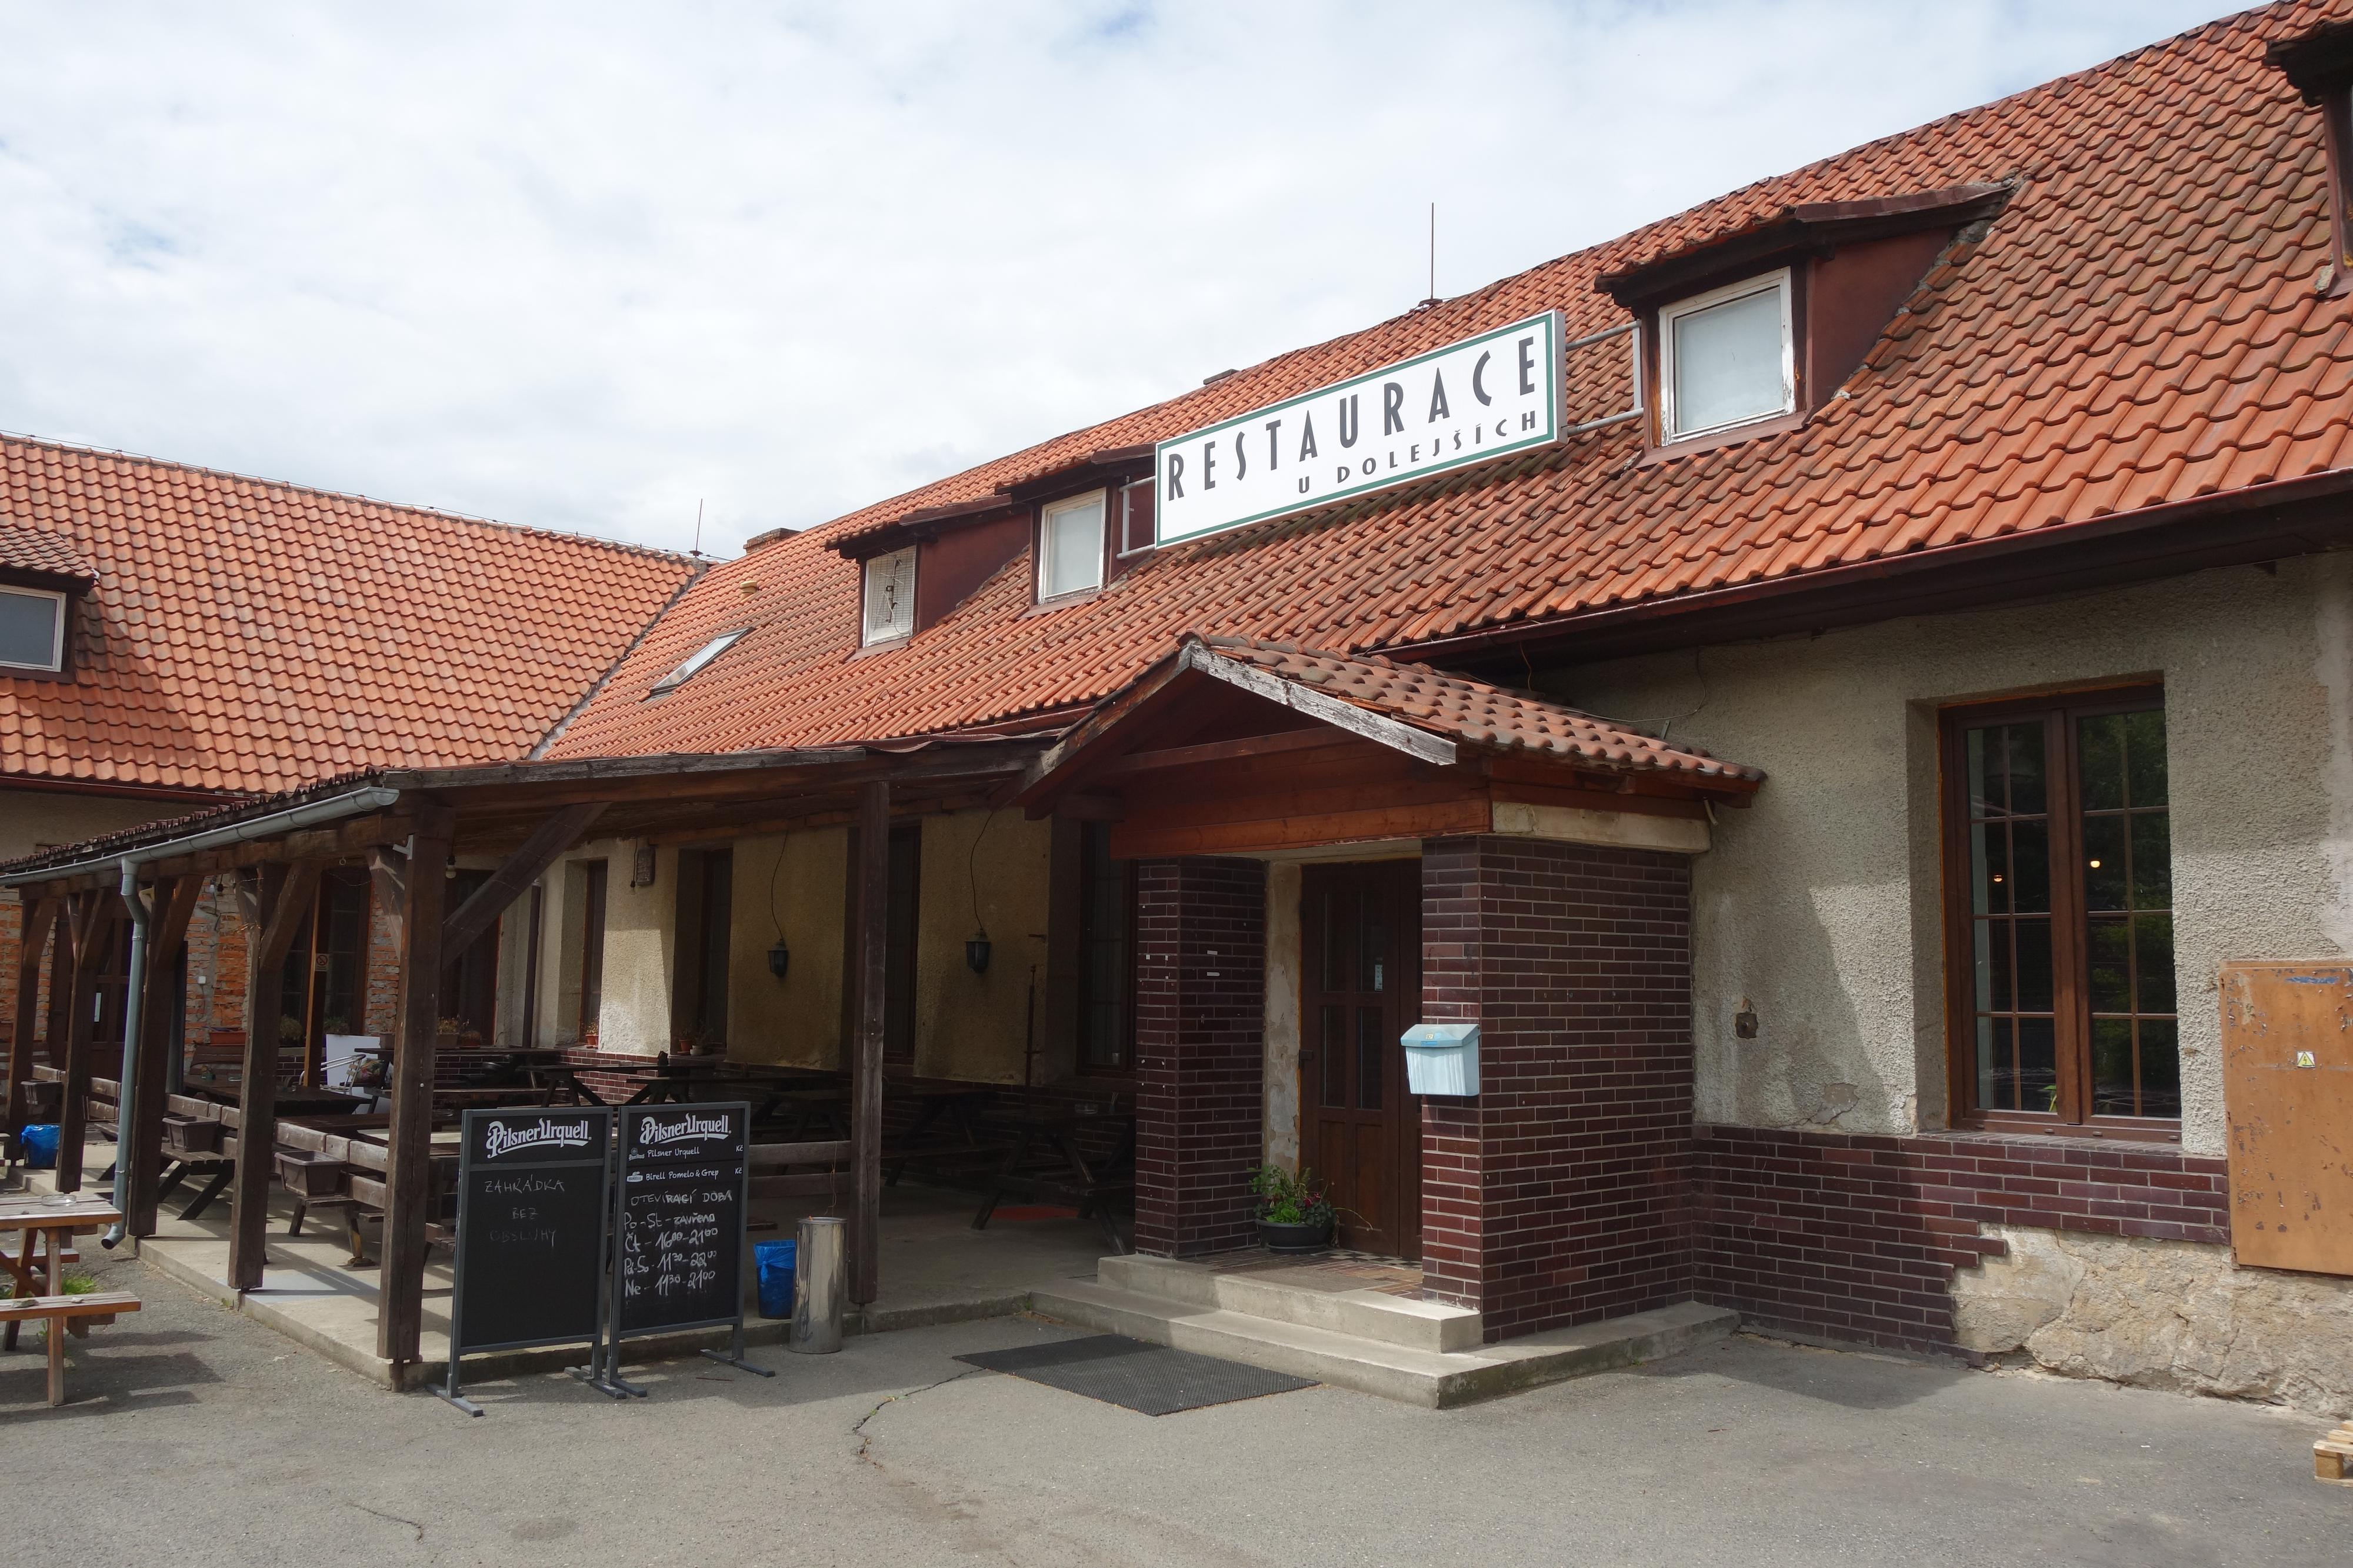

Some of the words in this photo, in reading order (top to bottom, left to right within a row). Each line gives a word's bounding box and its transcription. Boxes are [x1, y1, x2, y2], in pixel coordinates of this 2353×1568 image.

[1168, 336, 1535, 501] RESTAURACE
[1298, 476, 1309, 495] U
[1337, 410, 1537, 484] DOLEJŠÍCH
[486, 1120, 541, 1159] Pilsner
[539, 1117, 589, 1148] Urquell
[639, 1116, 687, 1145] Pilsner
[685, 1113, 729, 1142] Urquell
[647, 1148, 672, 1158] Pilsner
[674, 1147, 700, 1159] Urquell
[484, 1174, 565, 1194] ZAHRÁDKA
[646, 1170, 666, 1181] Birell
[669, 1169, 694, 1179] Pomelo
[701, 1169, 719, 1180] Grep
[512, 1207, 539, 1220] BEZ
[625, 1278, 641, 1298] Ne
